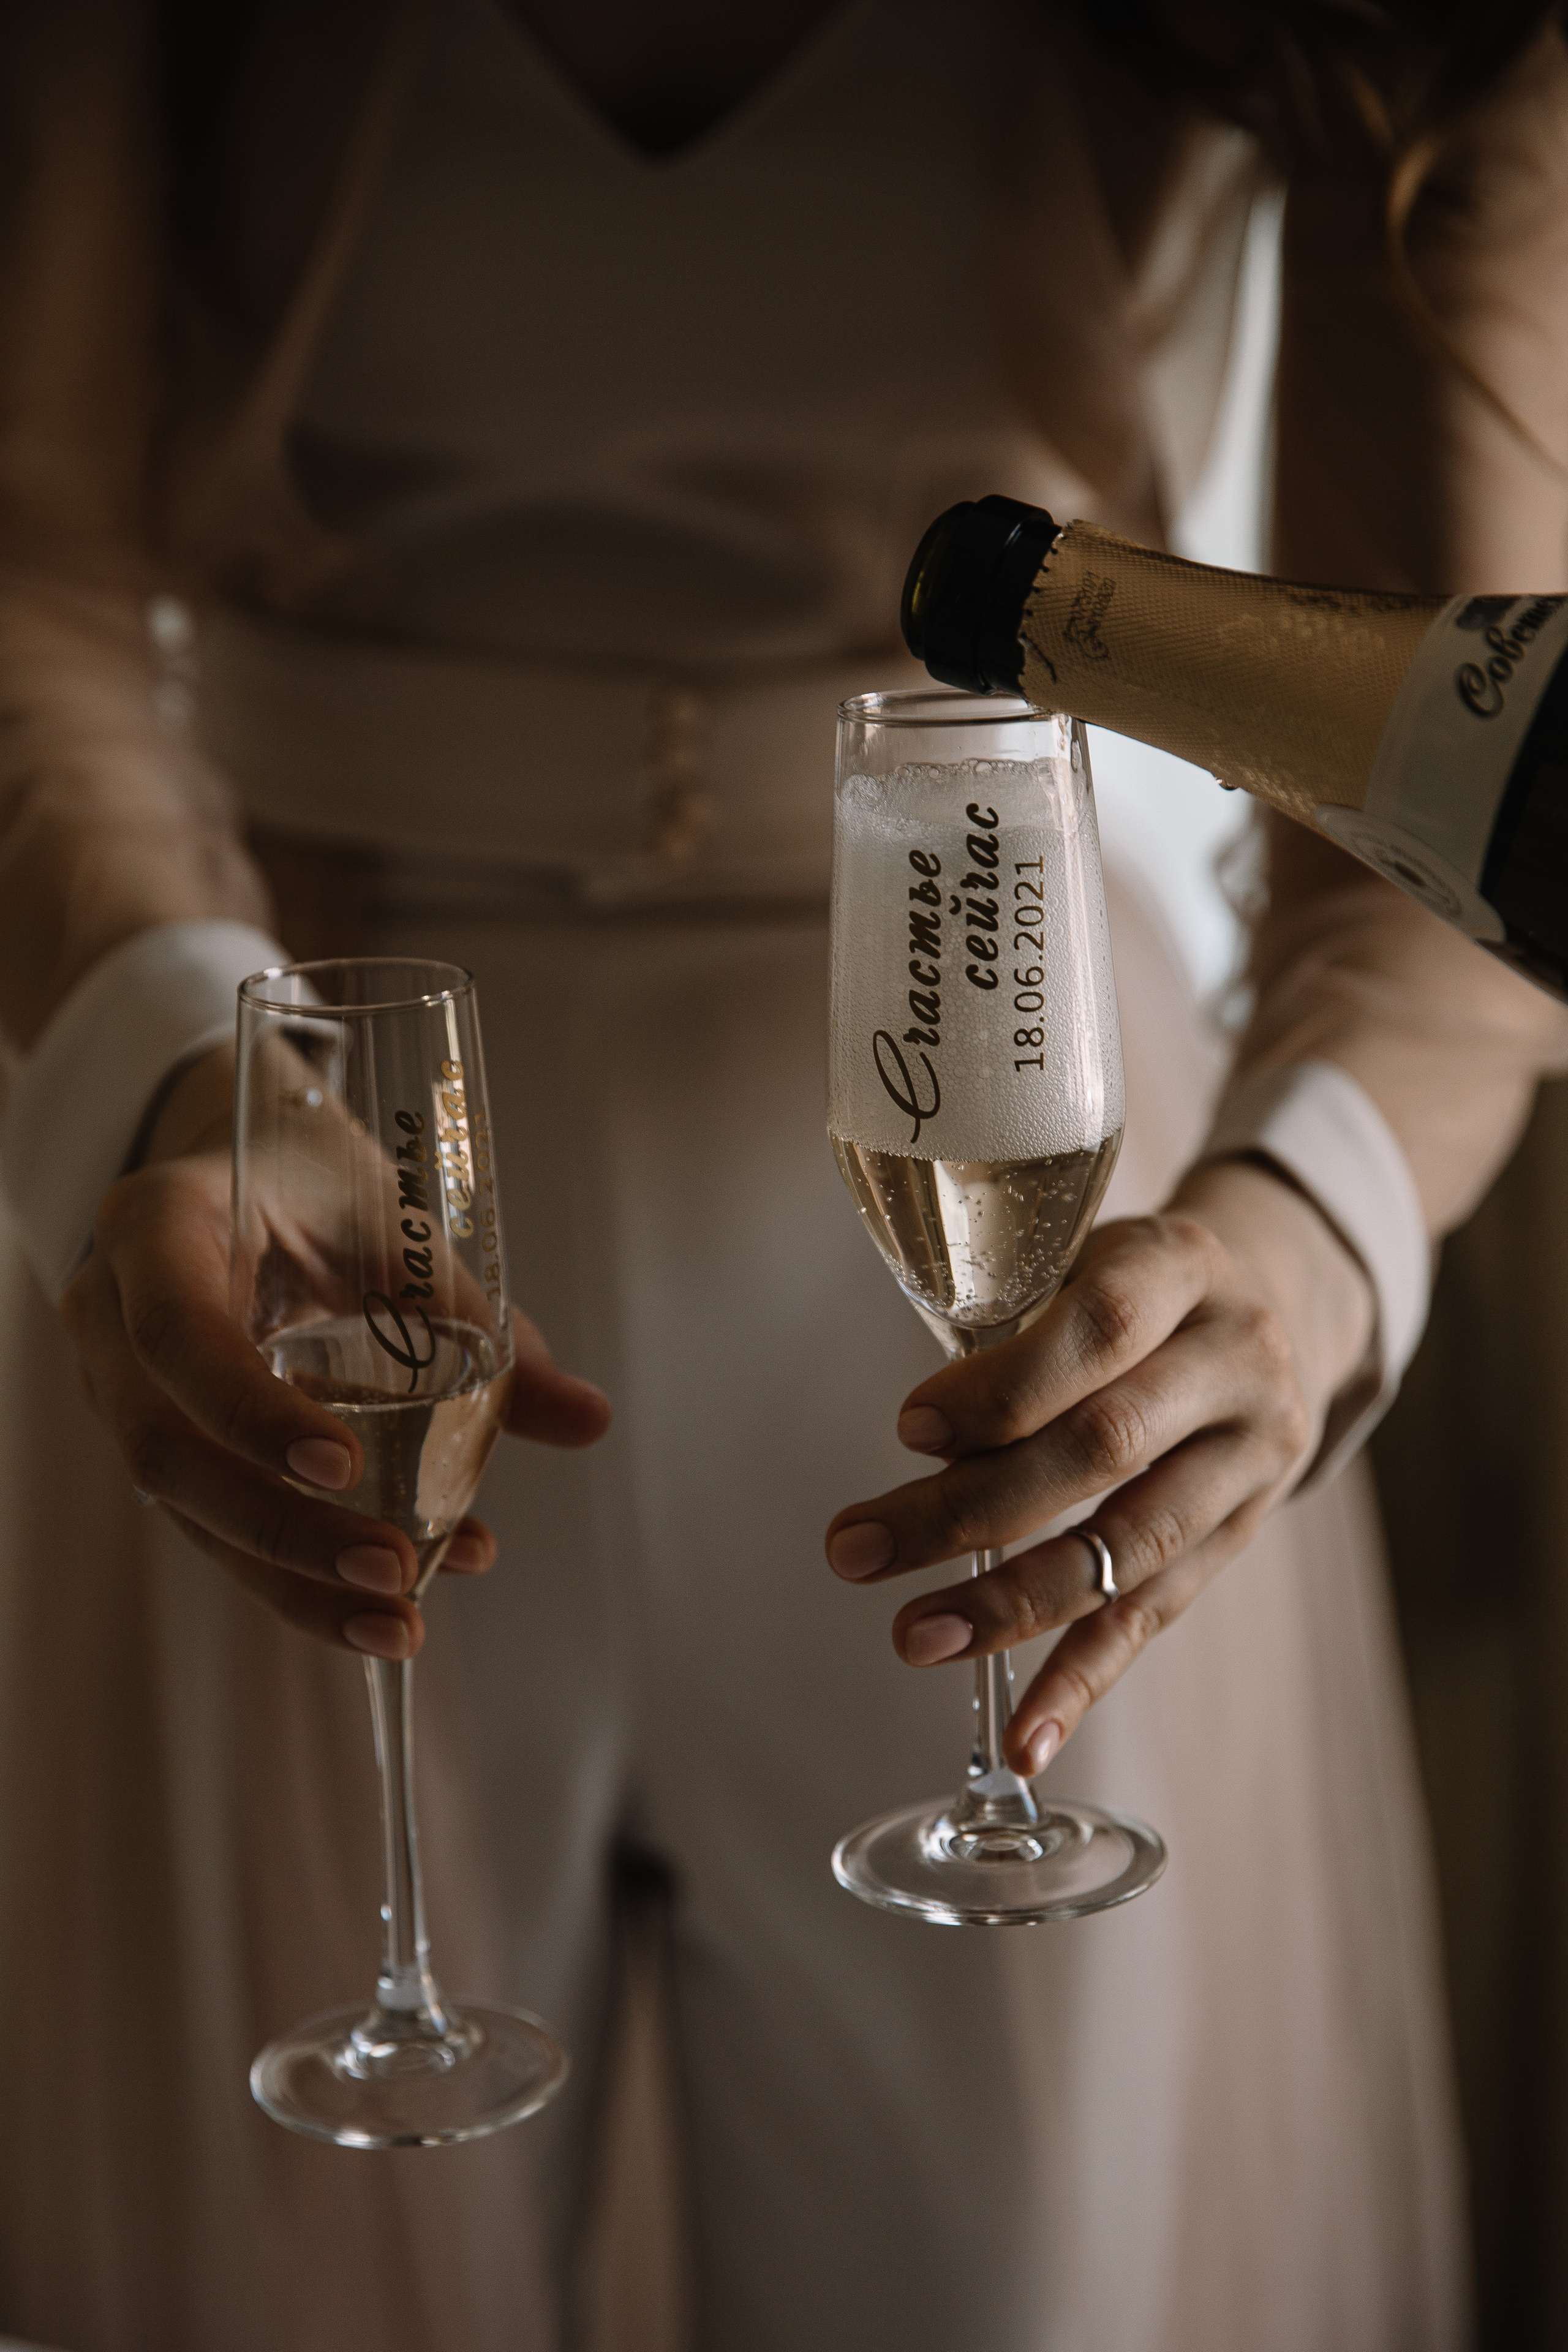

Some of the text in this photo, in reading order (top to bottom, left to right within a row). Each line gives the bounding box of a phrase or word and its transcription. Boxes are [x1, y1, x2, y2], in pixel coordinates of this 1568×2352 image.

[873, 850, 941, 1144] Счастье
[949, 803, 999, 990] сейчас
[1014, 856, 1045, 1072] 18.06.2021
